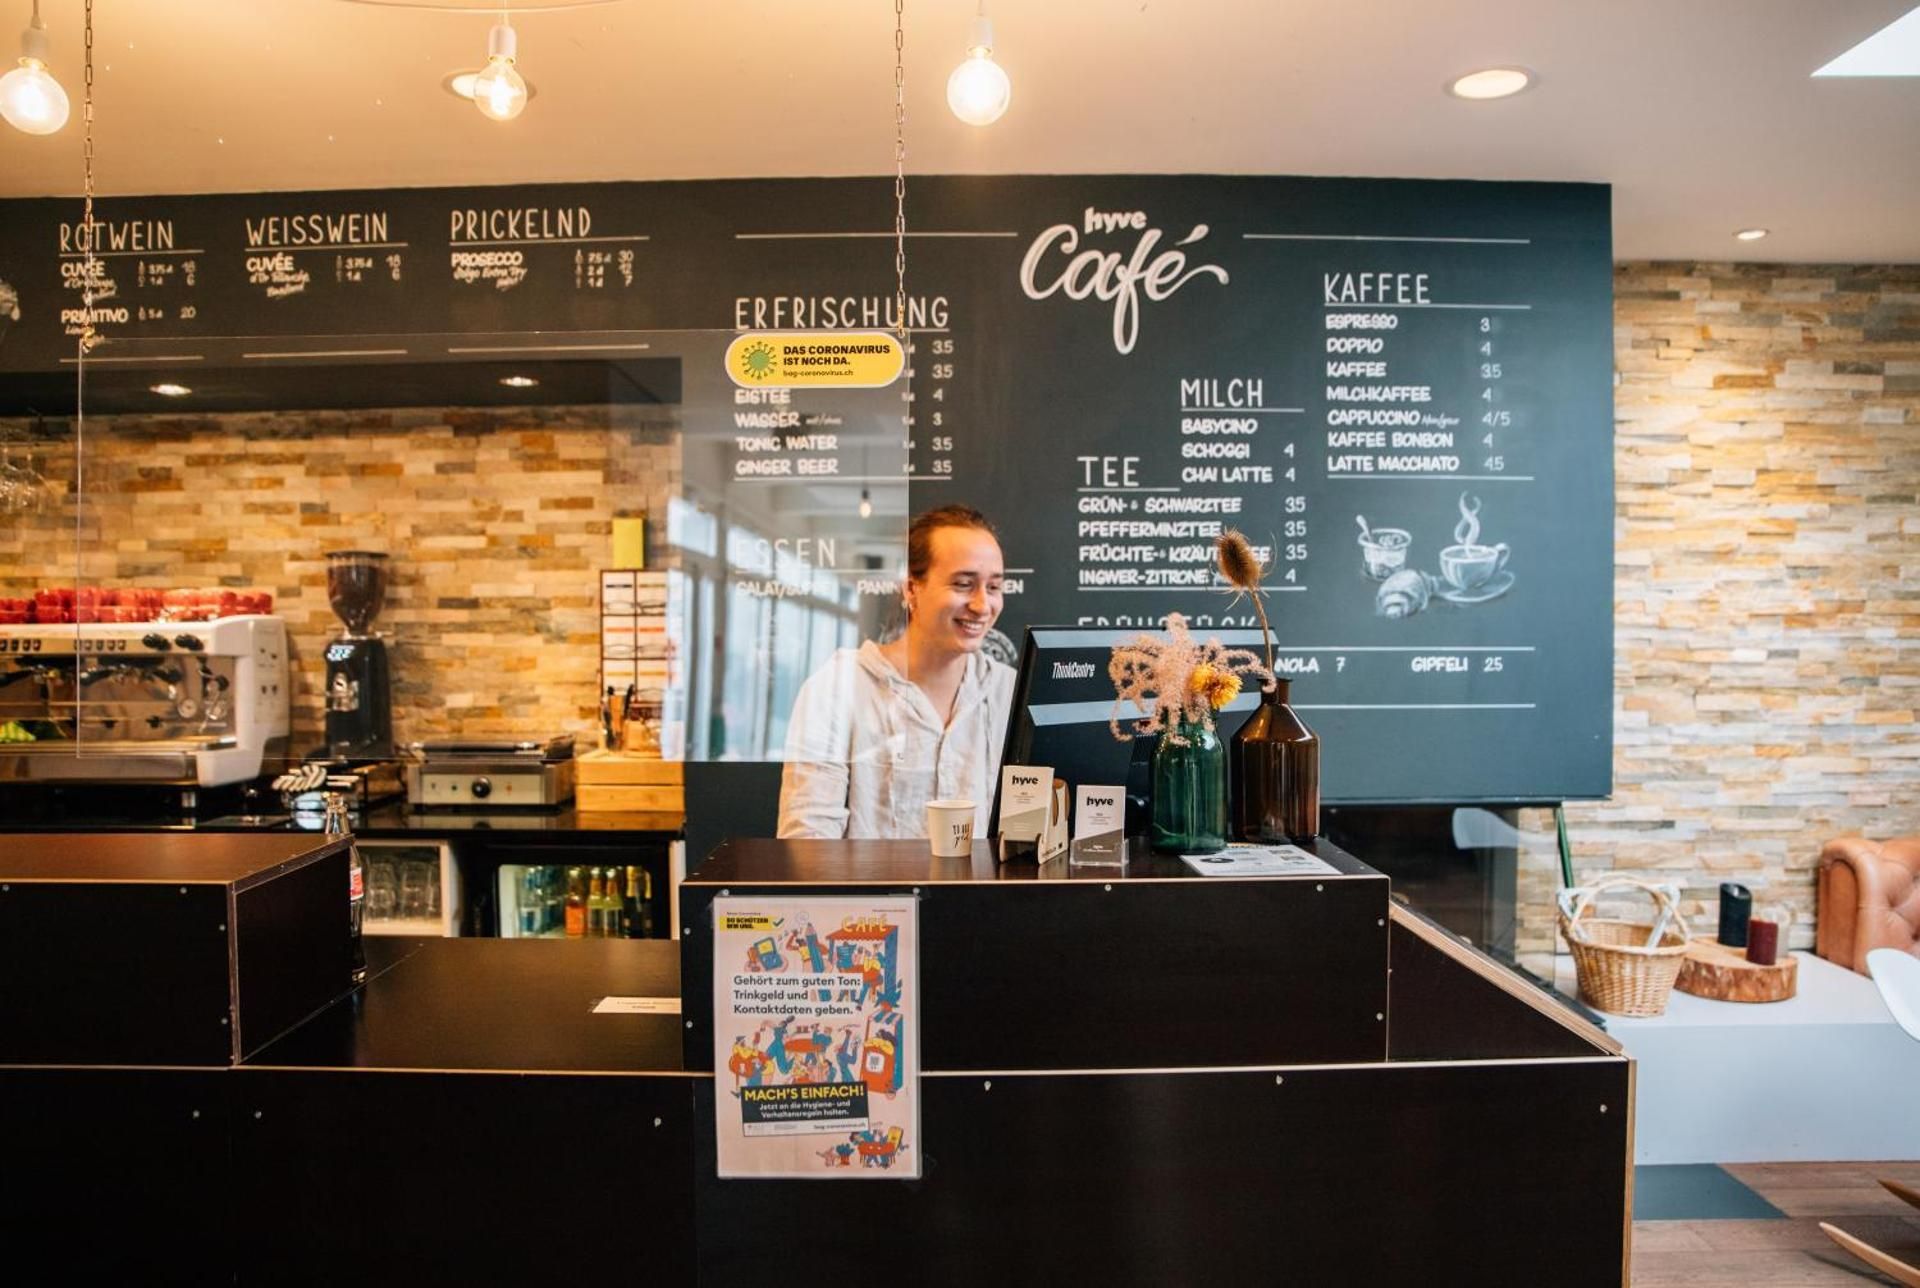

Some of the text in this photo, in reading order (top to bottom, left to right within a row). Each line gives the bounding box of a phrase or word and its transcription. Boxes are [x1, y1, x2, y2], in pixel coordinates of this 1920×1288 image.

[451, 207, 592, 241] PRICKELND
[1084, 206, 1147, 235] hyve
[60, 220, 174, 251] ROTWEIN
[246, 213, 388, 246] WEISSWEIN
[246, 252, 294, 273] CUVÉE
[451, 251, 523, 268] PROSECCO
[1020, 223, 1230, 355] Café
[1324, 273, 1431, 304] KAFFEE
[735, 297, 949, 330] ERFRISCHUNG
[1326, 314, 1491, 332] ESPRESSO 3
[783, 345, 890, 356] DAS CORONAVIRUS
[1326, 338, 1491, 356] DOPPIO 4
[783, 357, 851, 366] IST NOCH DA.
[1327, 361, 1387, 378] KAFFEE
[783, 369, 854, 379] bag-coronavirus.ch
[735, 388, 791, 404] EISTEE
[932, 388, 943, 403] 4
[1181, 378, 1263, 407] MILCH
[1326, 385, 1492, 403] MILCHKAFFEE 4
[734, 411, 800, 428] WASSER
[932, 411, 943, 427] 3
[1181, 418, 1259, 435] BABYCINO
[1327, 409, 1420, 426] CAPPUCCINO
[1482, 410, 1511, 427] 4/5
[735, 435, 781, 453] TONIC
[785, 434, 838, 451] WATER
[1328, 432, 1493, 448] KAFFEE BONBON 4
[1181, 443, 1295, 459] SCHOGGI 4
[735, 459, 792, 476] GINGER
[797, 458, 839, 475] BEER
[1077, 456, 1140, 487] TEE
[1327, 456, 1374, 473] LATTE
[1378, 455, 1460, 472] MACCHIATO
[1181, 467, 1296, 483] CHAI LATTE 4
[1144, 496, 1242, 514] SCHWARZTEE
[1078, 520, 1222, 538] PFEFFERMINZTEE
[735, 538, 837, 569] ESSEN
[1078, 543, 1158, 563] FRÜCHTE-
[1284, 568, 1297, 584] 4
[1052, 661, 1095, 679] ThinkCentre
[1335, 656, 1346, 673] 7
[1411, 656, 1468, 673] GIPFELI
[1011, 775, 1040, 786] hyve
[1086, 796, 1115, 807] hyve
[734, 975, 861, 989] Gehört zum guten Ton:
[734, 989, 809, 1003] Trinkgeld und
[733, 1004, 854, 1017] Kontaktdaten geben.
[744, 1085, 864, 1101] MACH'S EINFACH!
[759, 1103, 778, 1111] Jetzt
[790, 1102, 801, 1110] die
[836, 1099, 851, 1108] und
[761, 1109, 822, 1119] Verhaltensregeln
